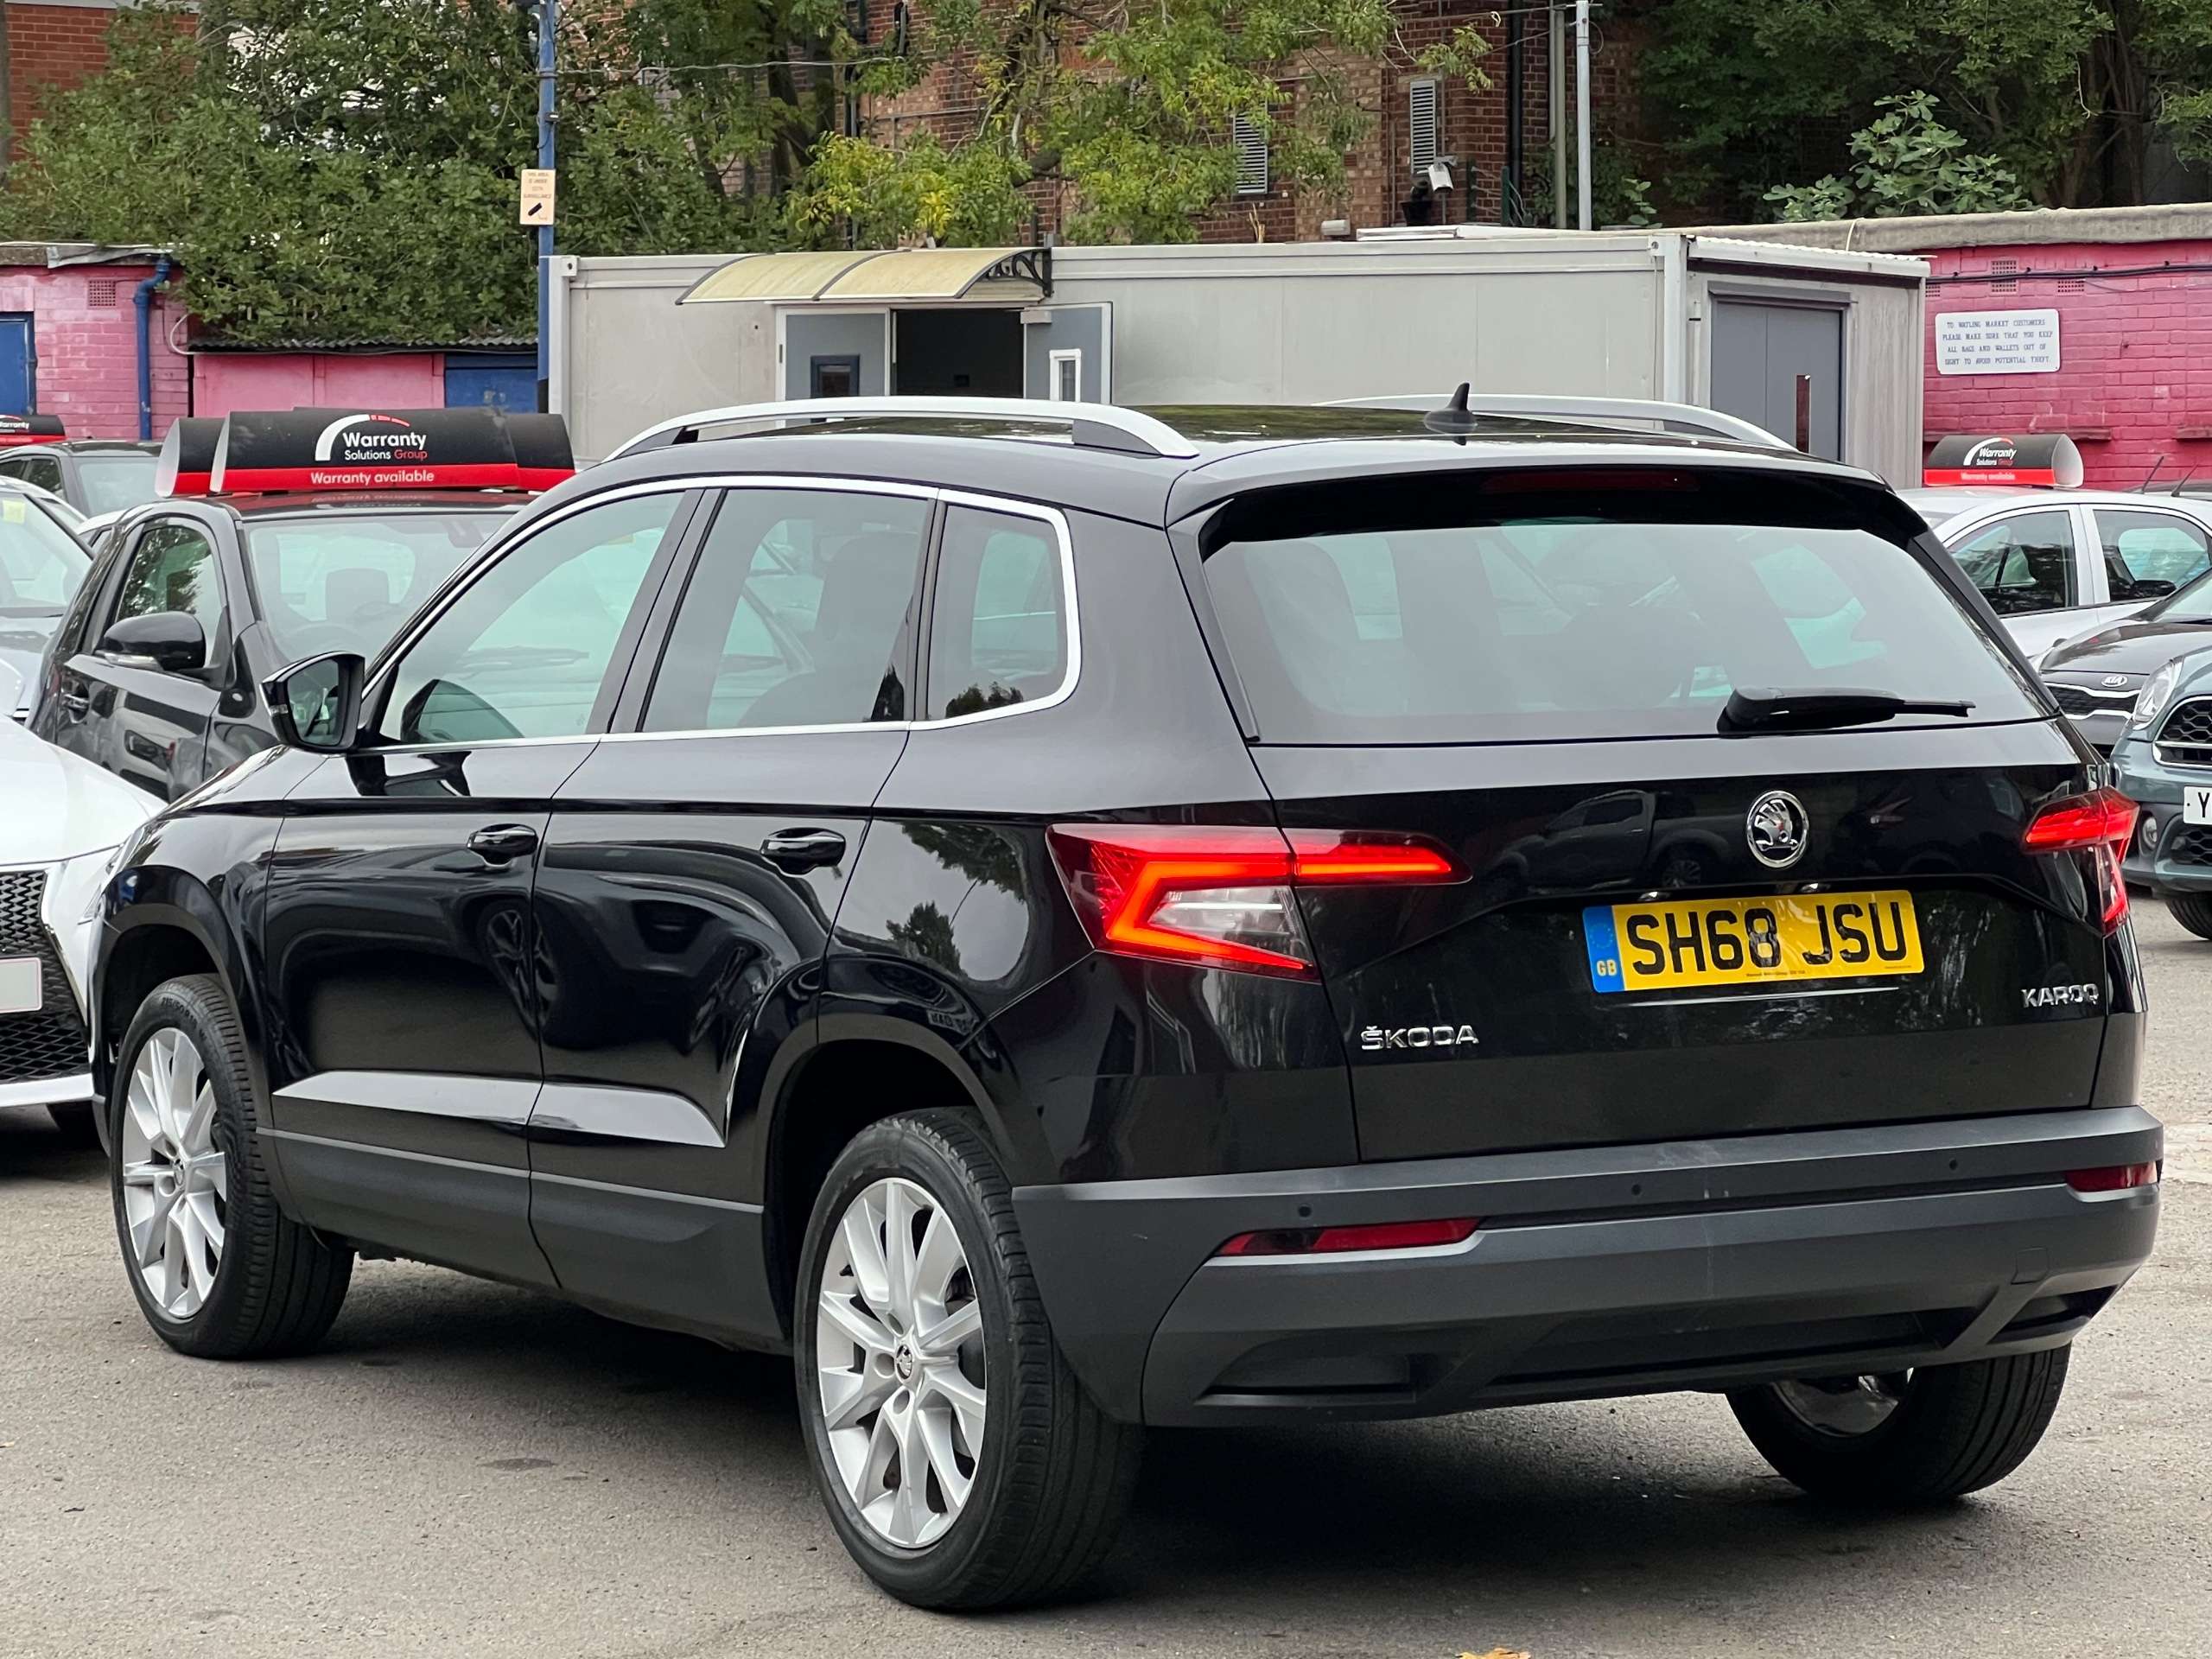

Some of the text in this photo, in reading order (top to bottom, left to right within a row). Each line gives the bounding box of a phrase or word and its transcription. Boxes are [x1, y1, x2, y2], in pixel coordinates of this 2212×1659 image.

[342, 432, 427, 450] Warranty
[344, 449, 429, 461] Solutions Group
[1979, 448, 2017, 460] Warranty
[311, 469, 435, 486] Warranty available
[2103, 675, 2126, 685] KIA
[1626, 901, 1907, 976] SH68 JSU
[1596, 959, 1617, 977] GB
[2021, 983, 2099, 1008] KAROQ
[1361, 1025, 1479, 1051] ŠKODA
